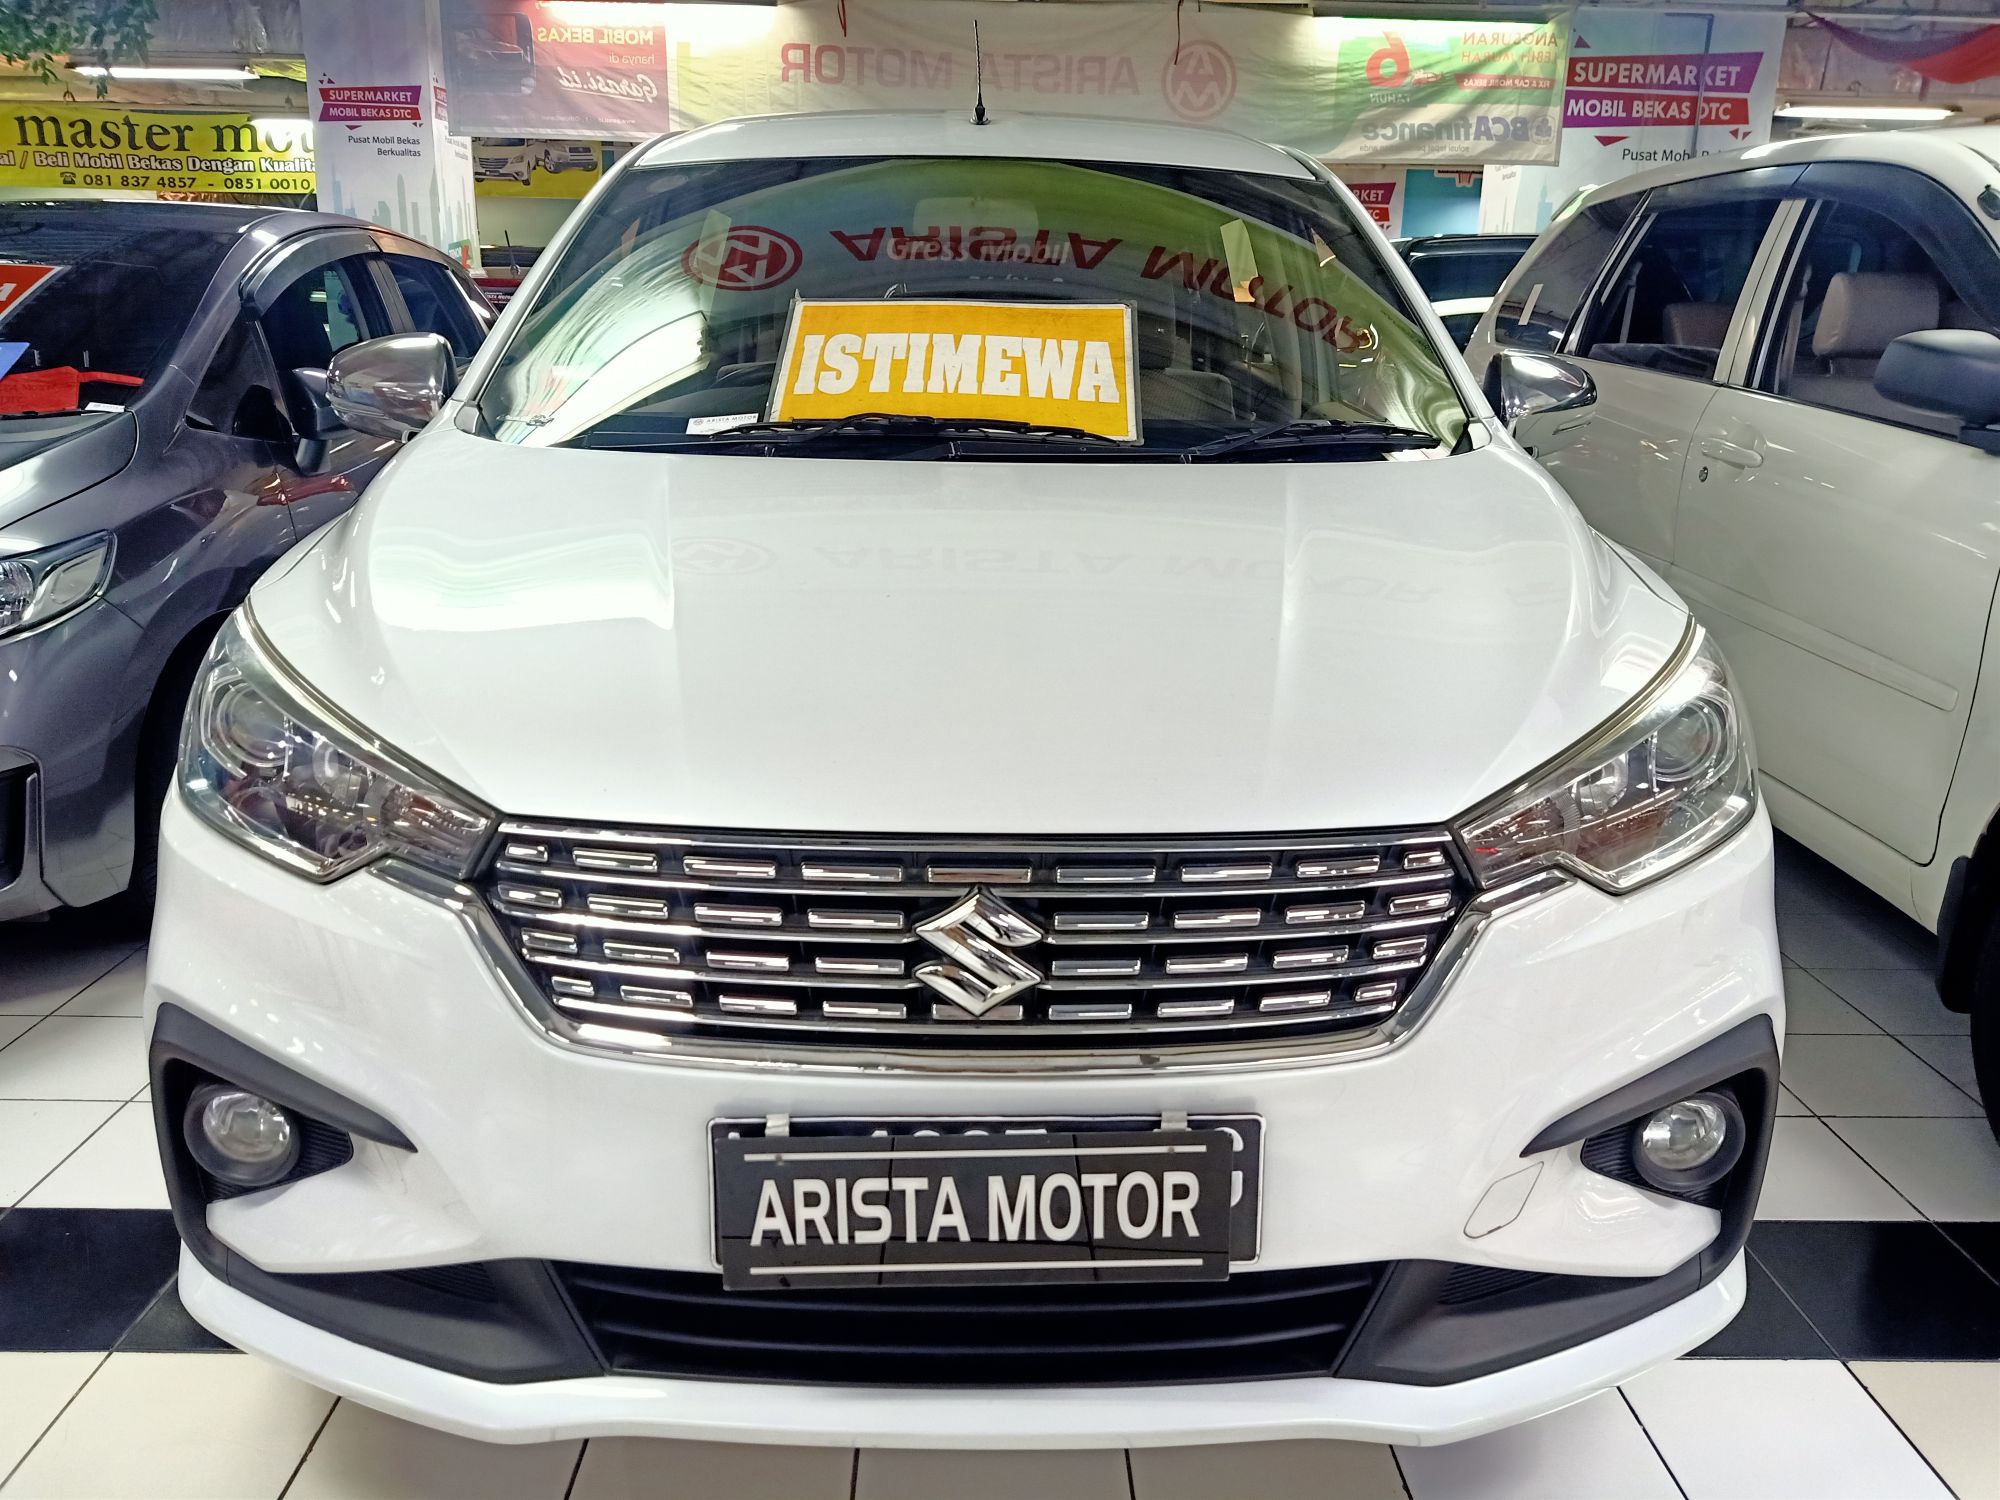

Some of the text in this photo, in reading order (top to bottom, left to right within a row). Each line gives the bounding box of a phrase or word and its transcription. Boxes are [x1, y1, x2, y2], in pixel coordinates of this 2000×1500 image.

[1573, 62, 1741, 86] SUPERMARKET
[329, 89, 412, 103] SUPERMARKET
[329, 106, 412, 119] MOBIL BEKAS DTC
[1566, 98, 1627, 118] MOBIL
[1631, 100, 1691, 120] BEKAS
[13, 114, 193, 151] master
[348, 135, 421, 146] Pusat Mobil Bekas
[33, 150, 70, 168] Beli
[73, 151, 123, 171] Mobil
[127, 153, 184, 172] Bekas
[186, 155, 256, 177] Dengan
[376, 147, 422, 158] Berkualitas
[1622, 149, 1658, 162] Pusat
[1661, 149, 1698, 162] Mob
[83, 174, 112, 187] 081
[120, 175, 150, 188] 837
[156, 176, 197, 189] 4857
[223, 177, 263, 190] 0851
[270, 178, 311, 191] 0010
[886, 237, 1071, 266] Gress Mobil
[793, 332, 1120, 404] ISTIMEWA
[750, 1170, 1200, 1247] ARISTA MOTOR
